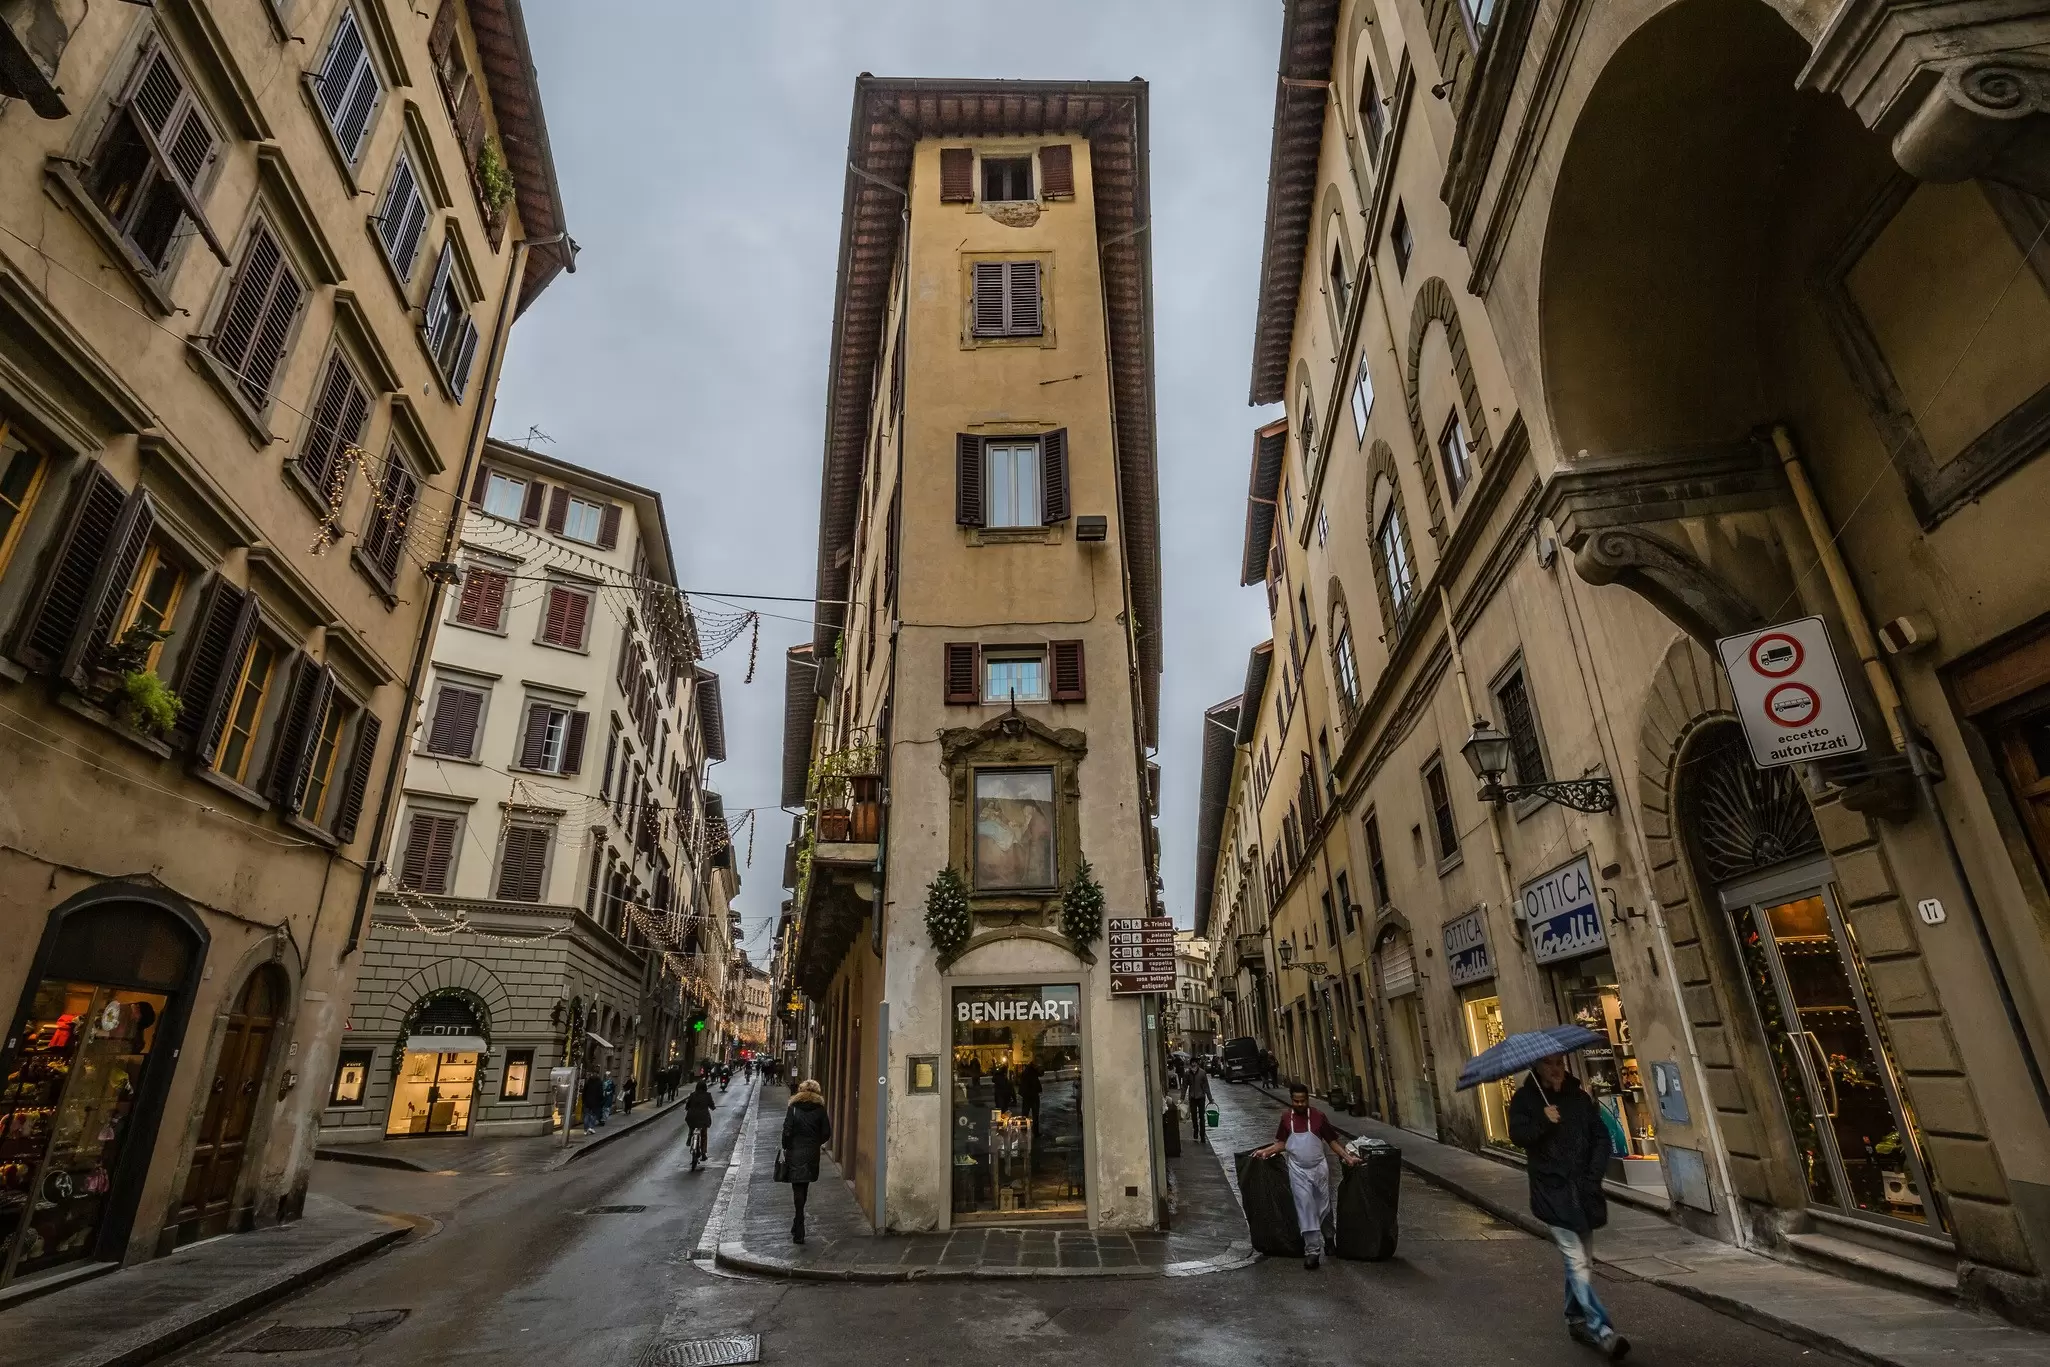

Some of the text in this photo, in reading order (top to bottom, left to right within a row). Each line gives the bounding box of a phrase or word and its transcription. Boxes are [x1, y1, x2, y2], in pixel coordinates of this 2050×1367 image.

[1771, 735, 1848, 759] autorizzati
[1778, 728, 1829, 743] eccetto
[1526, 868, 1591, 918] OTTICA
[1924, 902, 1938, 919] 17
[1445, 916, 1483, 950] OTTICA
[1532, 914, 1601, 958] Torelli
[1449, 951, 1490, 981] Torelli
[957, 1000, 1073, 1021] BENHEART
[420, 1025, 472, 1035] FONT
